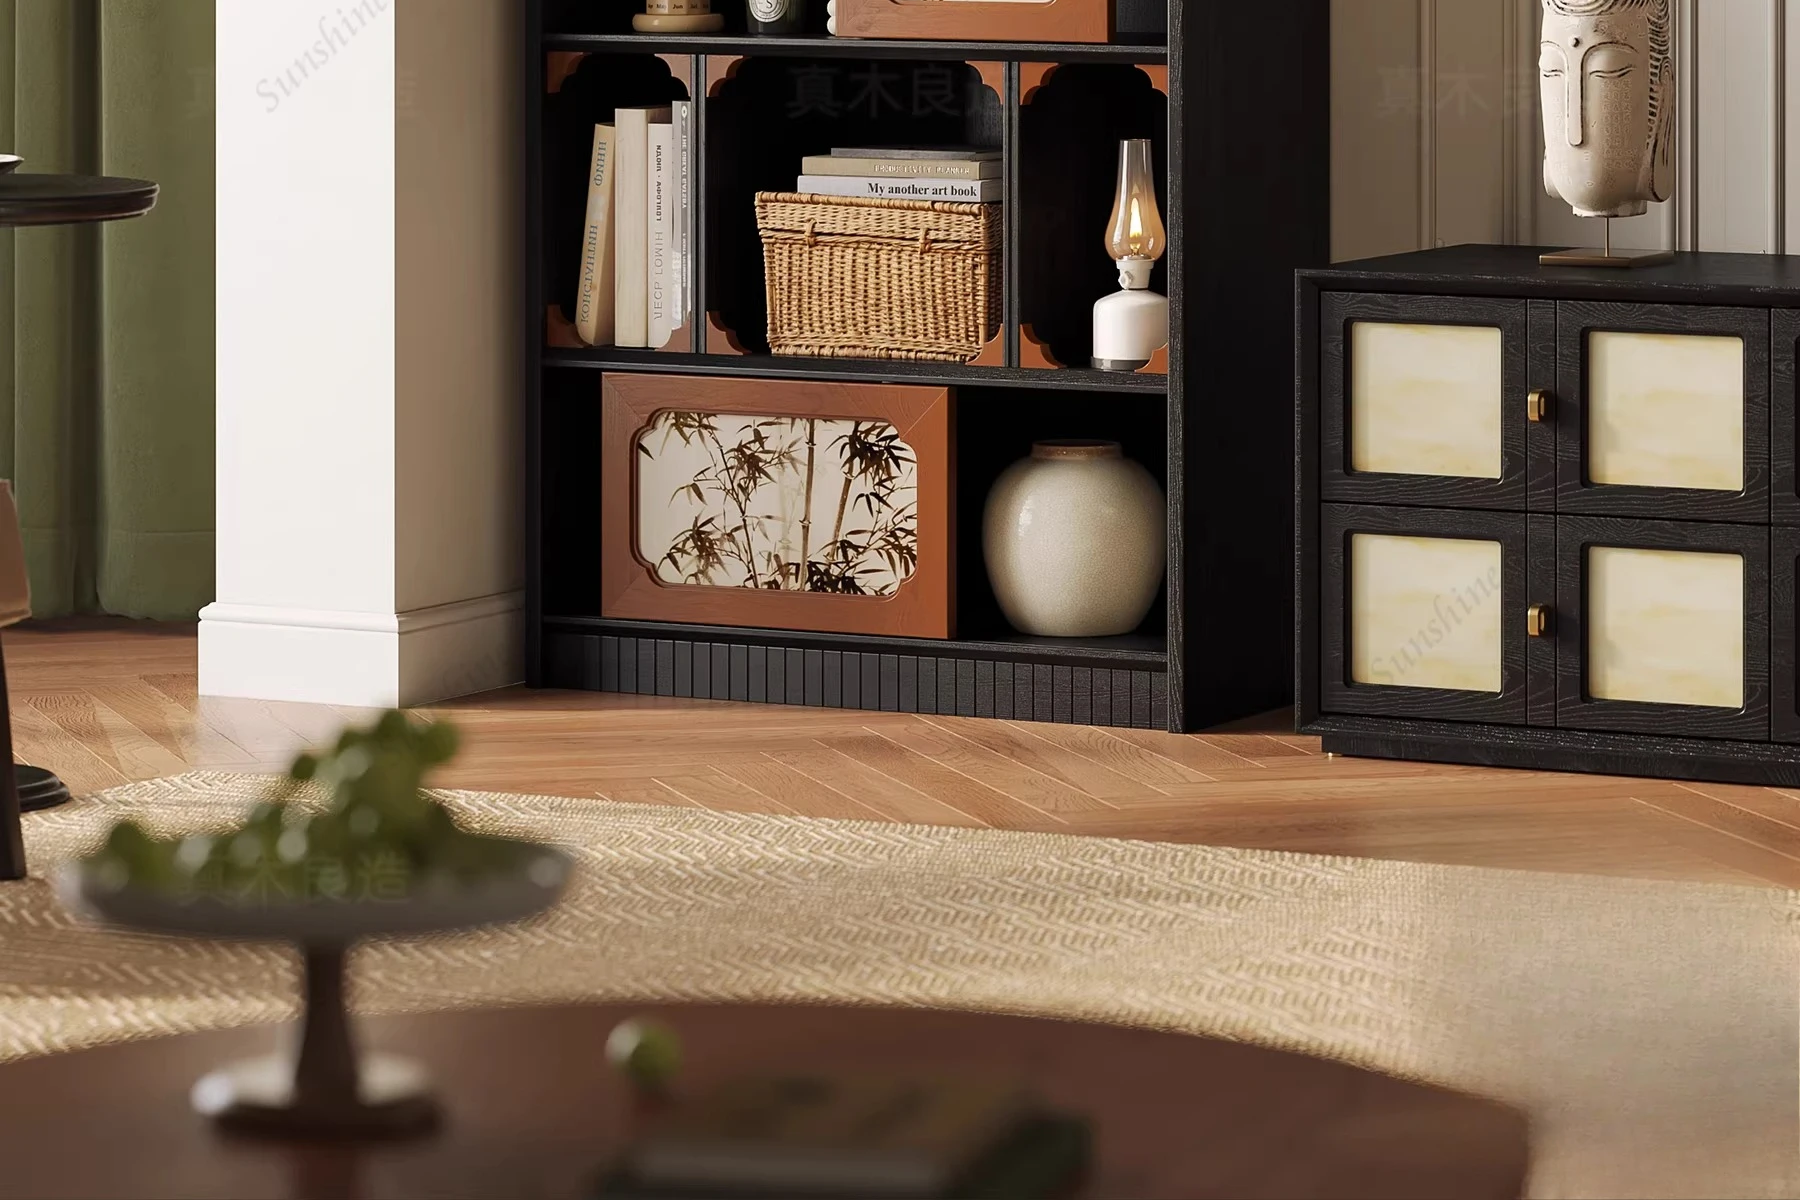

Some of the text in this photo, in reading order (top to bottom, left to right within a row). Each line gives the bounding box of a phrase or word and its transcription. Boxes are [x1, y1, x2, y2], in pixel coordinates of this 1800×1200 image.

[868, 182, 978, 197] My another art book
